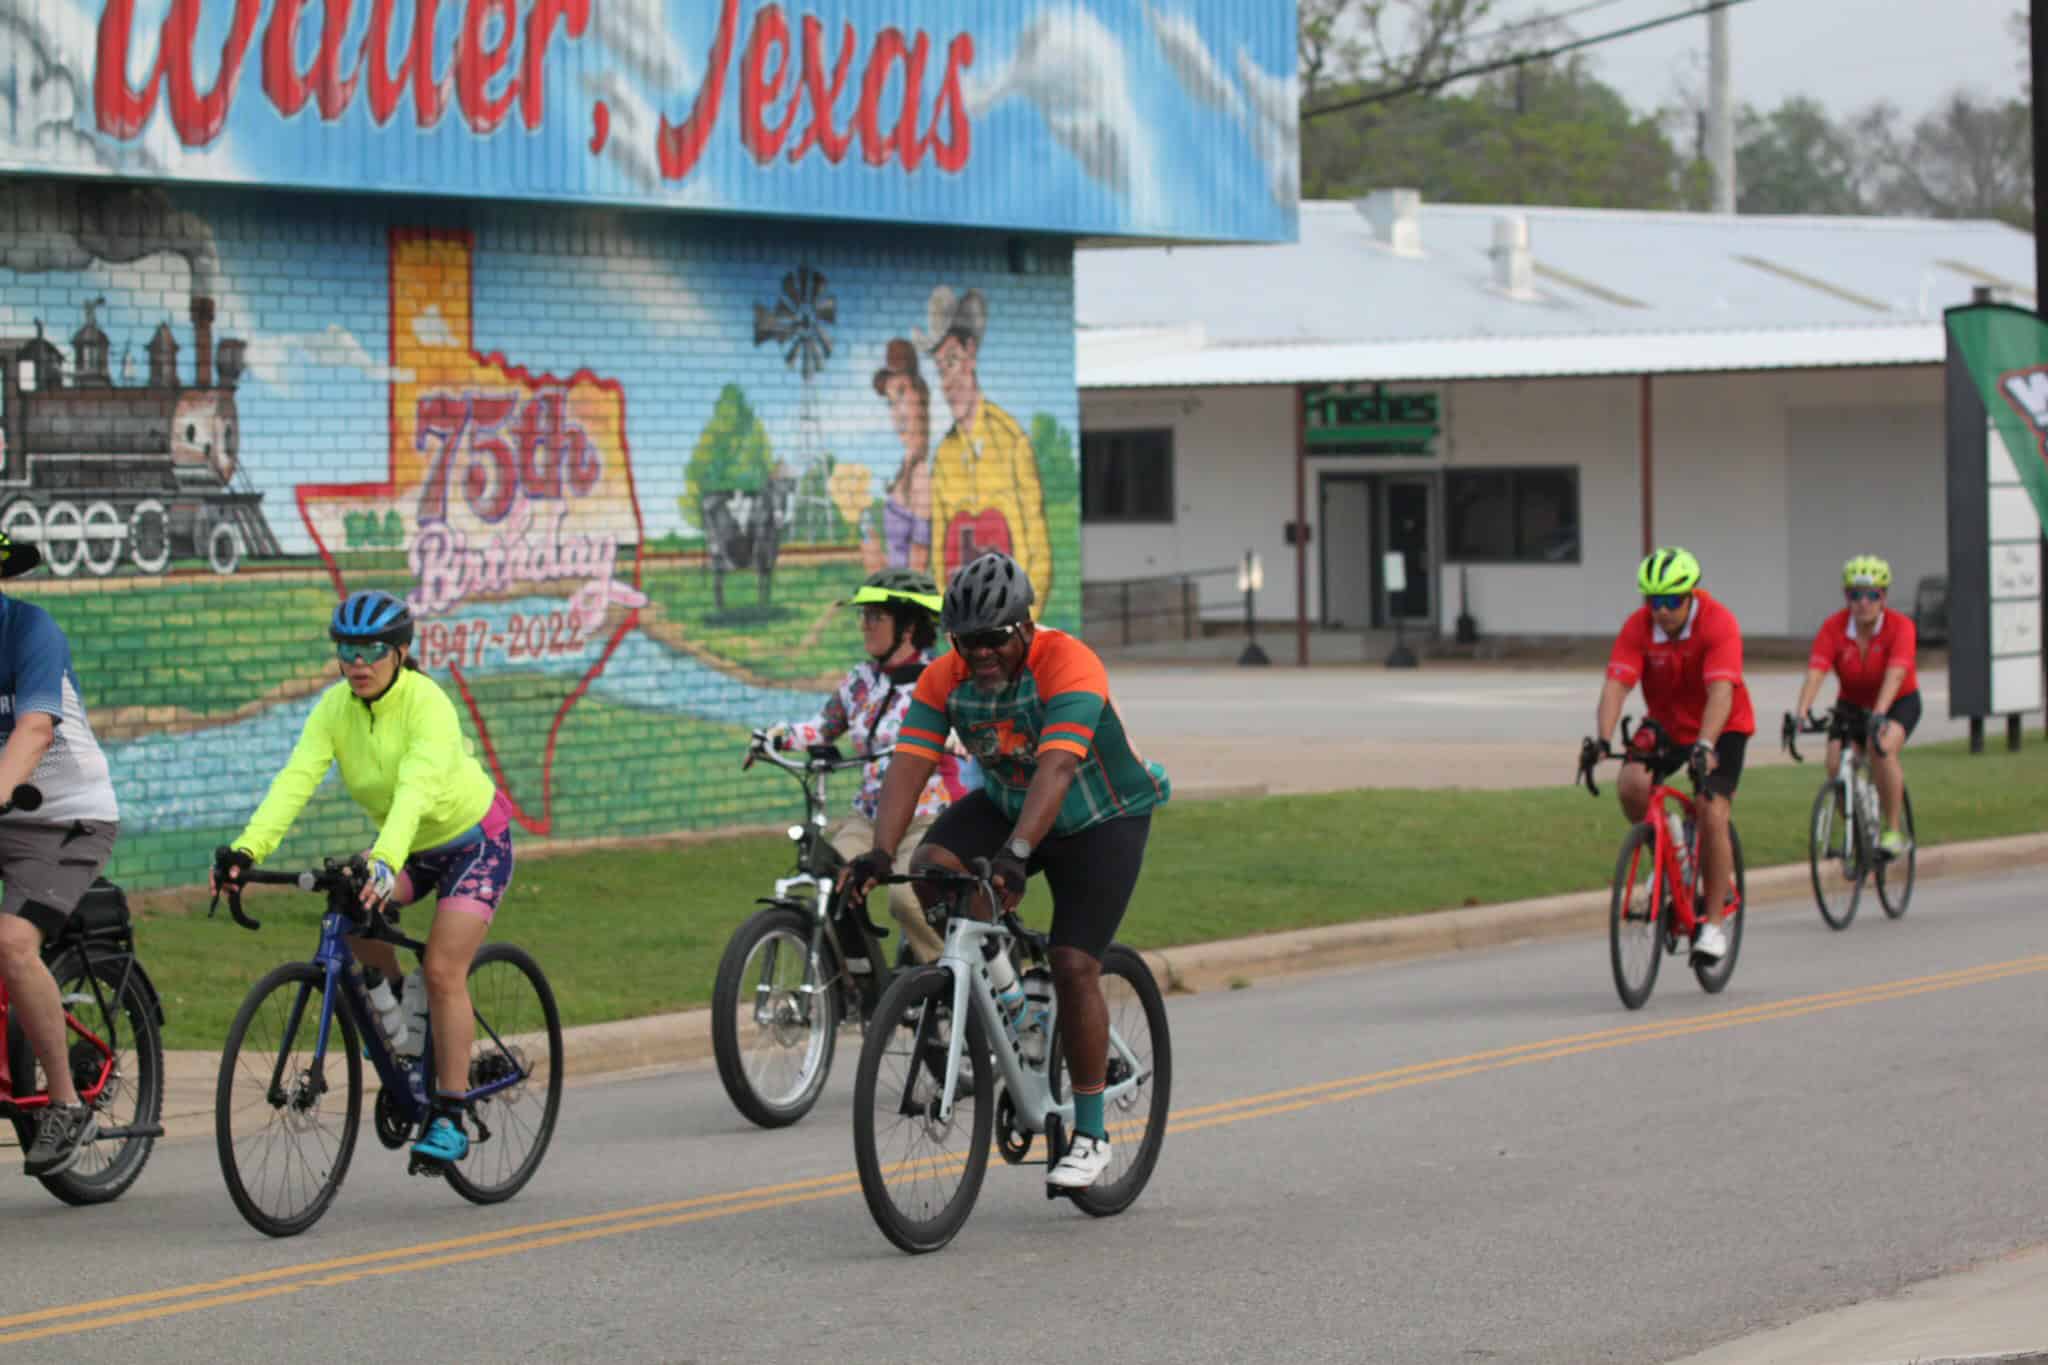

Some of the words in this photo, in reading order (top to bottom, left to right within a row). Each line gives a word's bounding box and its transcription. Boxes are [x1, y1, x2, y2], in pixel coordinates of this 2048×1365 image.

[658, 0, 974, 179] Texas
[415, 389, 600, 524] 75th
[406, 497, 648, 635] Birthday
